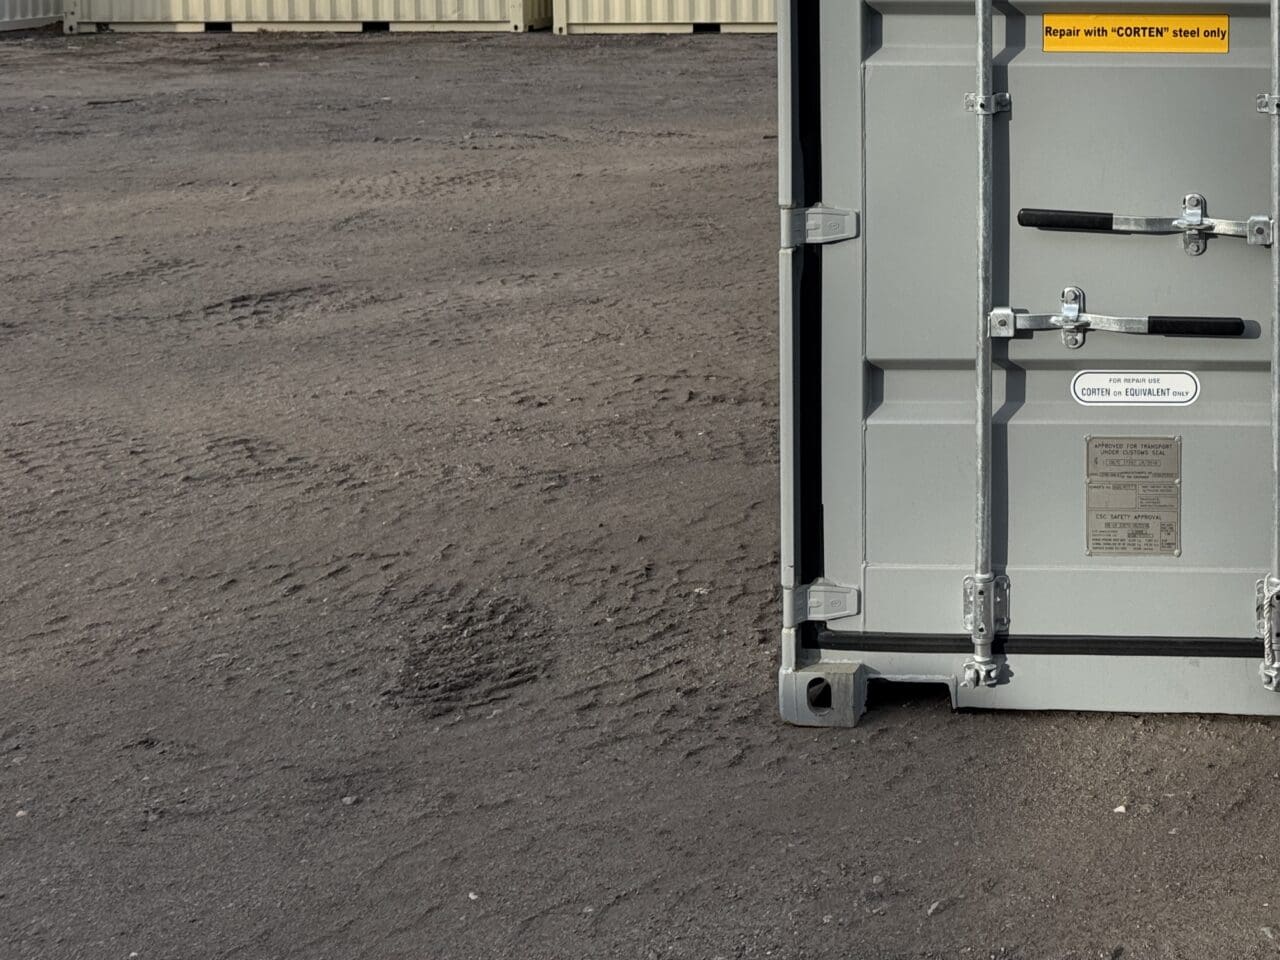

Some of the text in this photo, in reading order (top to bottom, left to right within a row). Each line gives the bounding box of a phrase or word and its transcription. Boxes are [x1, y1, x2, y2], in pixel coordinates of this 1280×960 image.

[1045, 27, 1080, 39] Repair
[1084, 27, 1108, 37] with
[1172, 27, 1200, 38] steel
[1203, 28, 1226, 40] only
[1081, 388, 1110, 396] CORTEN
[1125, 388, 1170, 397] EQUIVALENT
